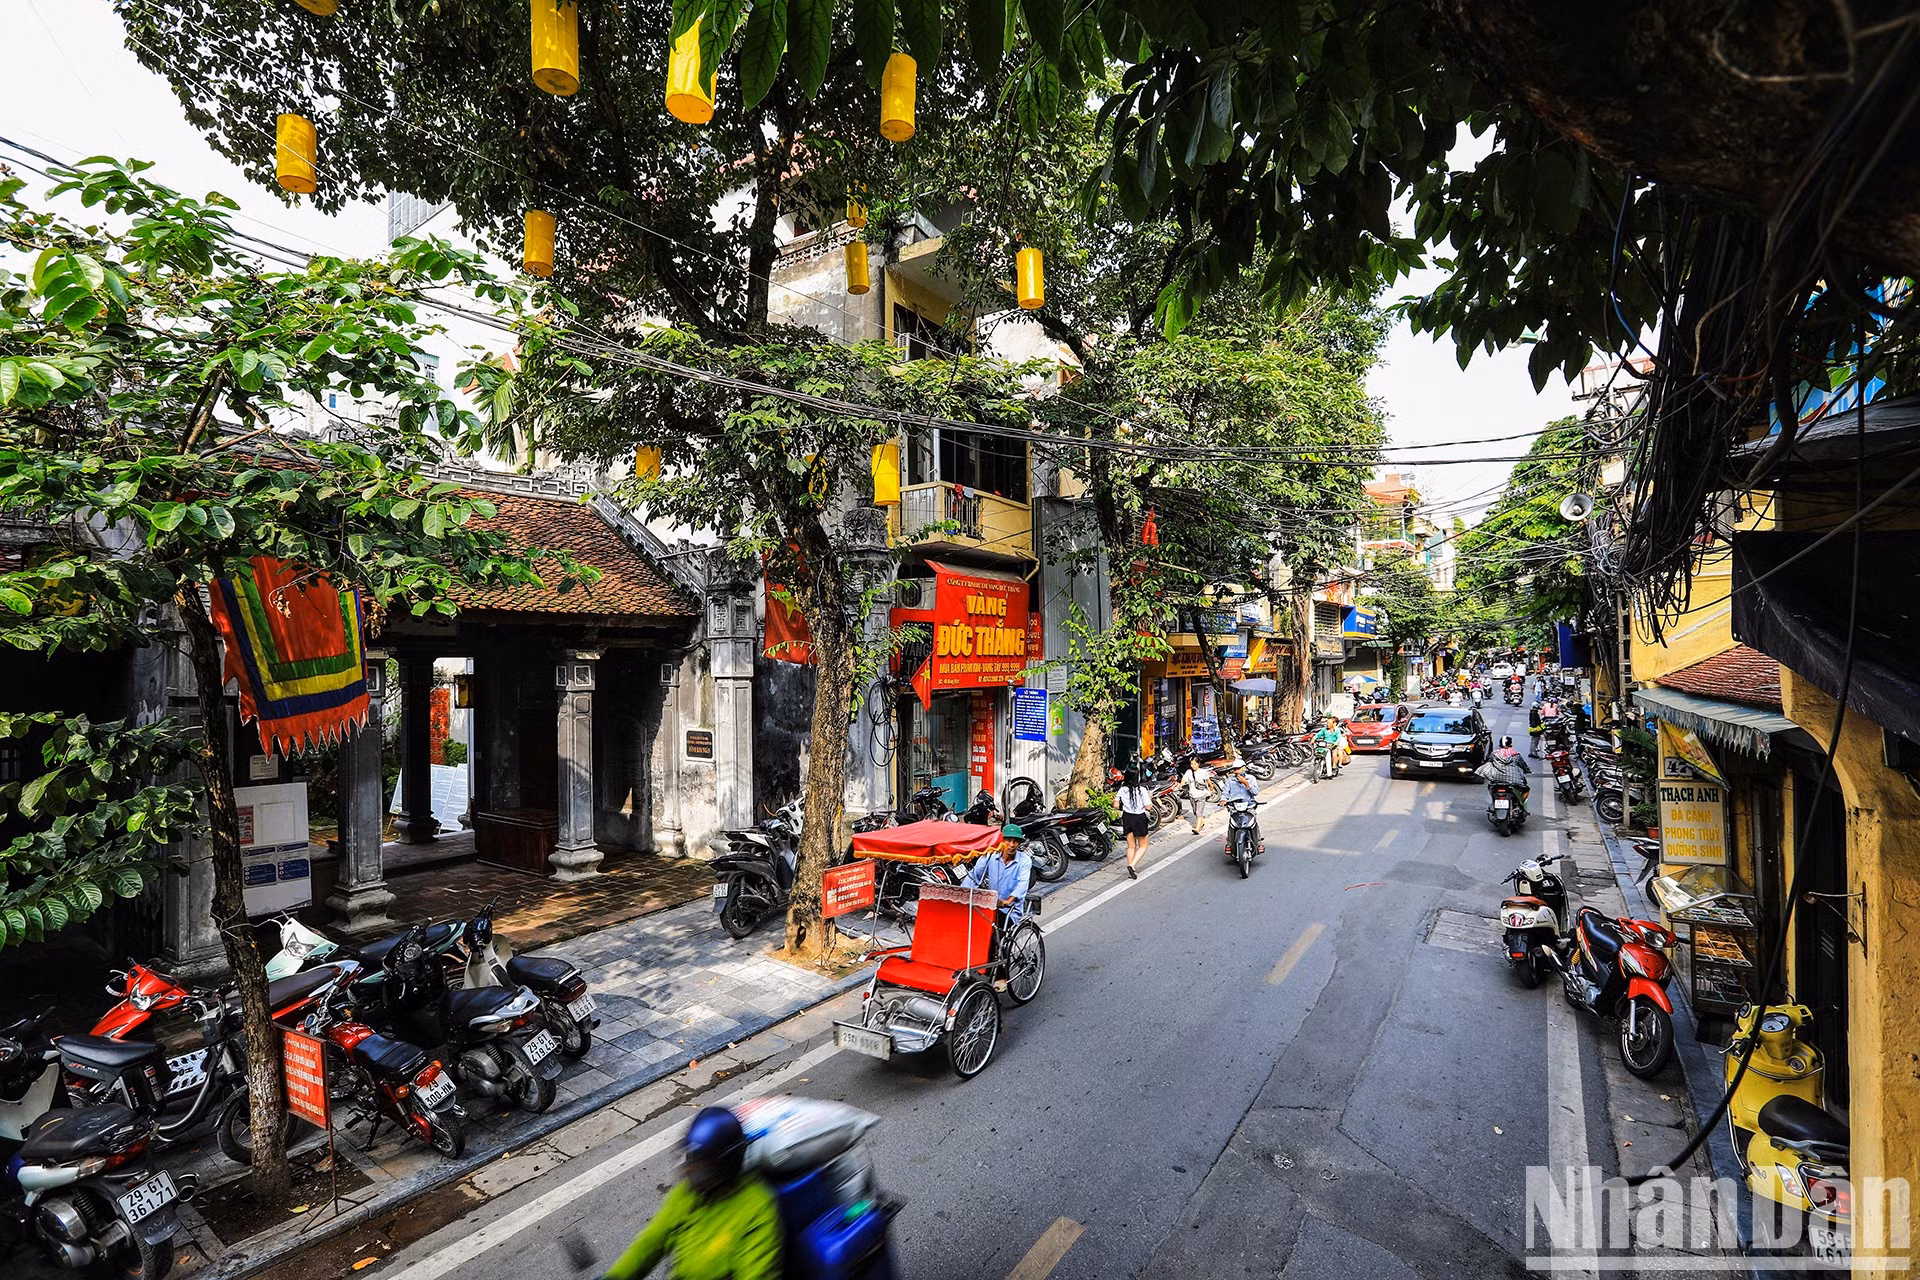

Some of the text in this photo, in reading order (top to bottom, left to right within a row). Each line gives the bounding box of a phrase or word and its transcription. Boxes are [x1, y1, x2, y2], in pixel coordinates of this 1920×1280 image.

[966, 592, 1007, 616] VÀNG
[937, 619, 972, 656] ĐỨC
[975, 619, 1025, 656] THẮNG
[1661, 787, 1719, 805] THẠCH ANH
[1686, 805, 1711, 822] CẢNH
[1665, 827, 1696, 840] PHONG
[1700, 845, 1722, 859] SINH
[575, 1002, 594, 1018] 5591
[126, 1177, 164, 1208] 29-G1
[128, 1186, 174, 1222] 361.71
